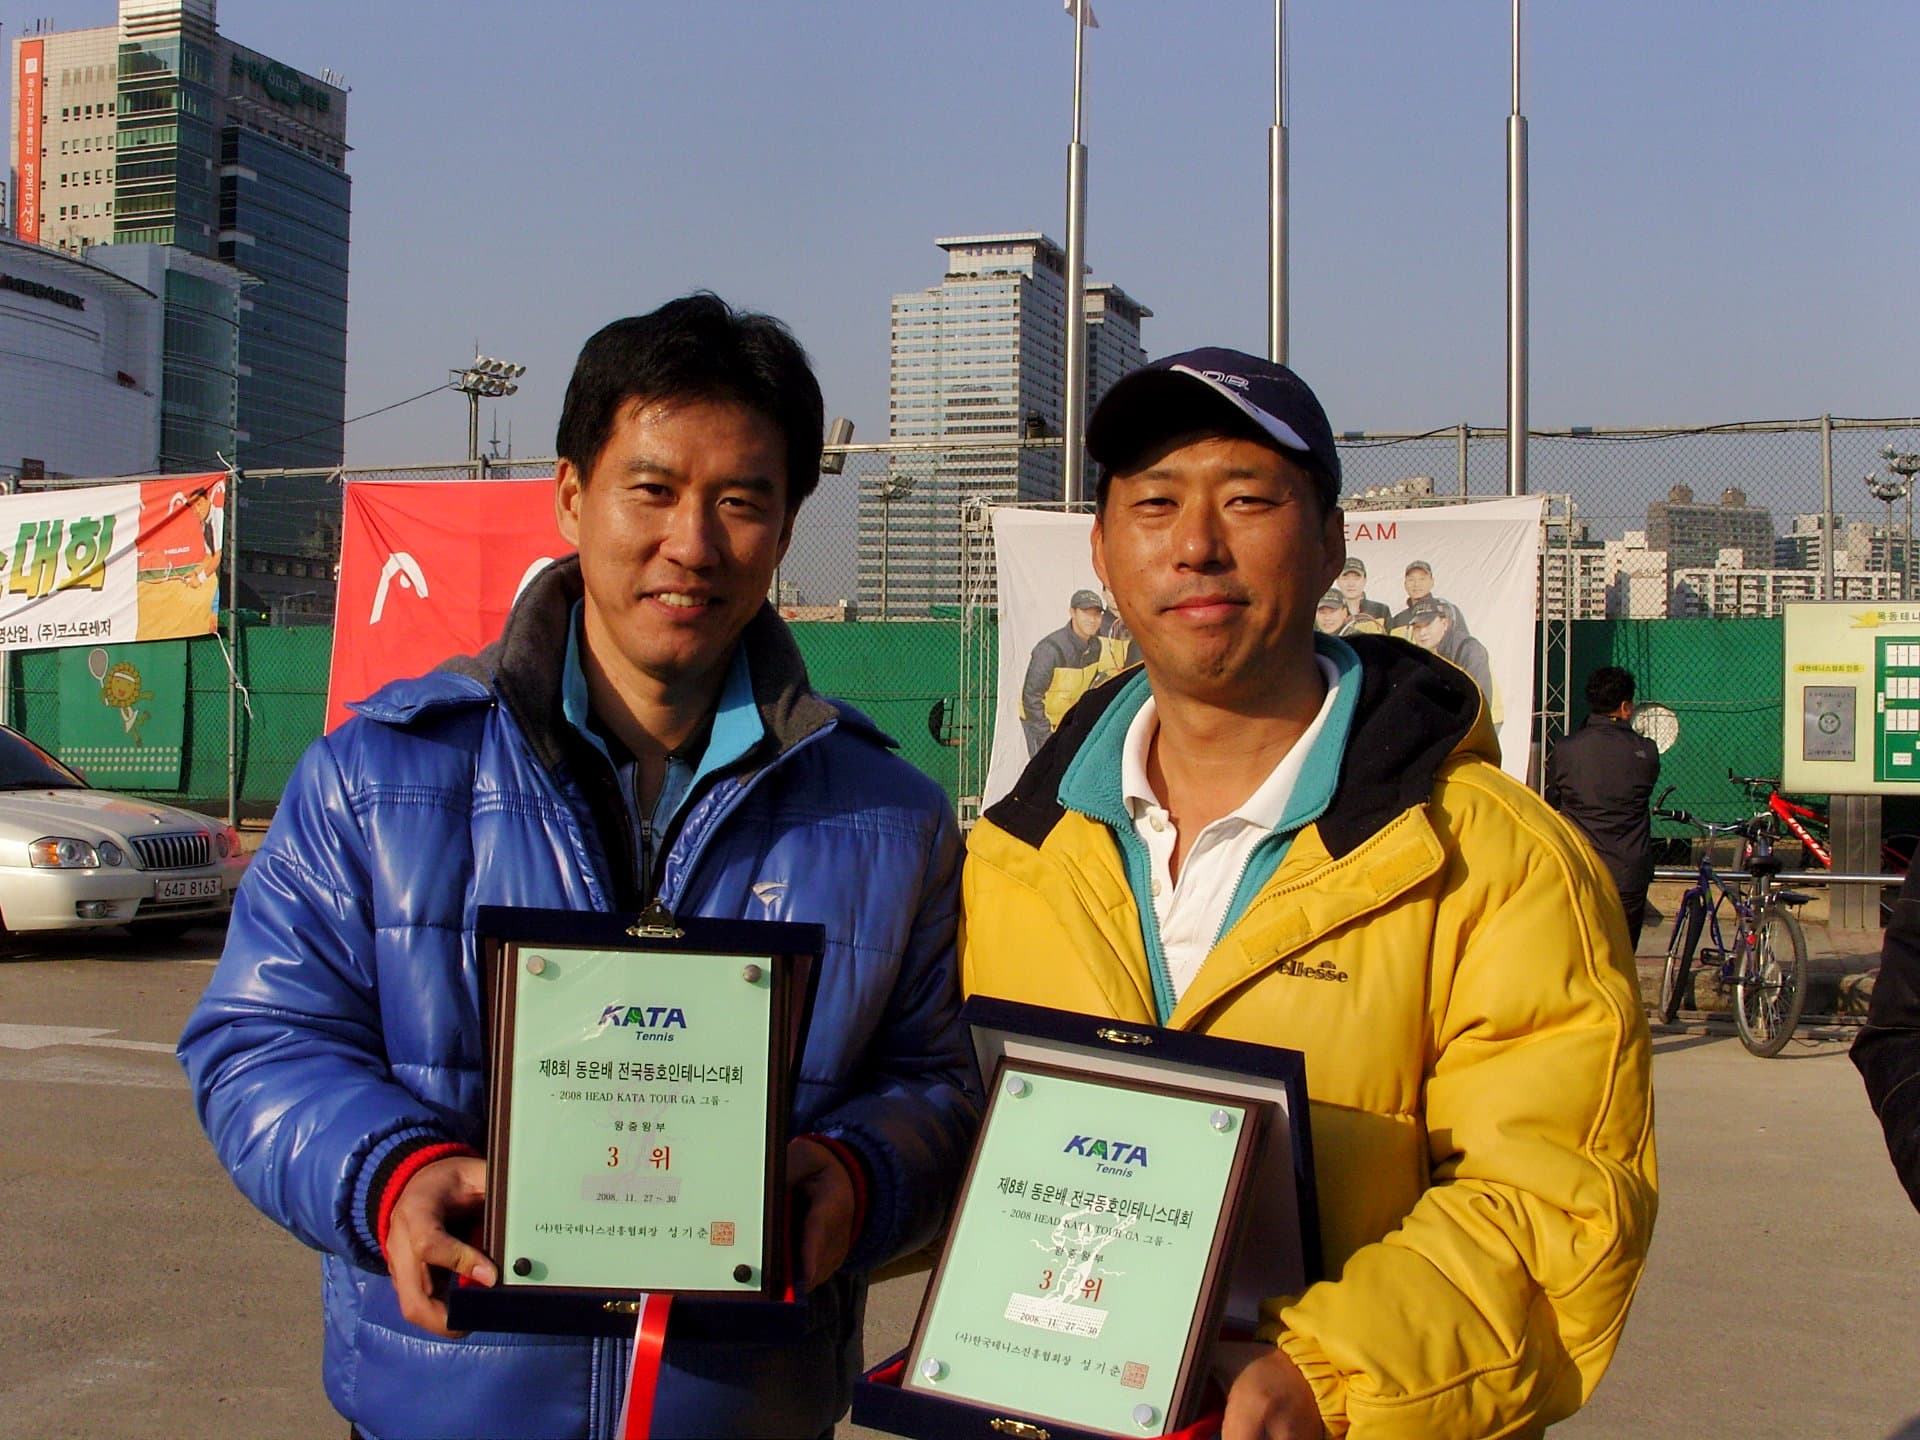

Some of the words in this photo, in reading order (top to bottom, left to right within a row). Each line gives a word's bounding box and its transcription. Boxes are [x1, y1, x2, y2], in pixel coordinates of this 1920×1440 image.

[1344, 522, 1397, 542] EAM
[0, 514, 116, 601] 대회
[37, 618, 112, 643] (주)코스모레저
[190, 879, 217, 896] 8163
[1278, 960, 1348, 982] ellesse
[598, 1005, 688, 1029] KATA
[635, 1031, 675, 1042] Tennis
[539, 1059, 571, 1079] 제8회
[575, 1060, 614, 1081] 동운배
[618, 1062, 744, 1085] 전국동호인테니스대회
[559, 1090, 582, 1101] 2008
[585, 1092, 613, 1102] HEAD
[617, 1092, 645, 1103] KATA
[650, 1094, 677, 1105] TOUR
[681, 1094, 696, 1105] GA
[699, 1095, 720, 1106] 그룹
[607, 1146, 620, 1168] 3
[649, 1145, 670, 1171] 위
[1063, 1135, 1150, 1168] KATA
[1095, 1162, 1133, 1178] Tennis
[997, 1176, 1028, 1198] 제8회
[1030, 1182, 1068, 1207] 동운배
[1070, 1189, 1194, 1229] 전국동호인테니스대회
[1010, 1208, 1032, 1221] 2008
[1033, 1213, 1061, 1227] HEAD
[1063, 1218, 1091, 1233] KATA
[1096, 1224, 1122, 1239] TOUR
[1125, 1230, 1140, 1242] GA
[1039, 1269, 1053, 1290] 3
[1080, 1277, 1104, 1303] 위
